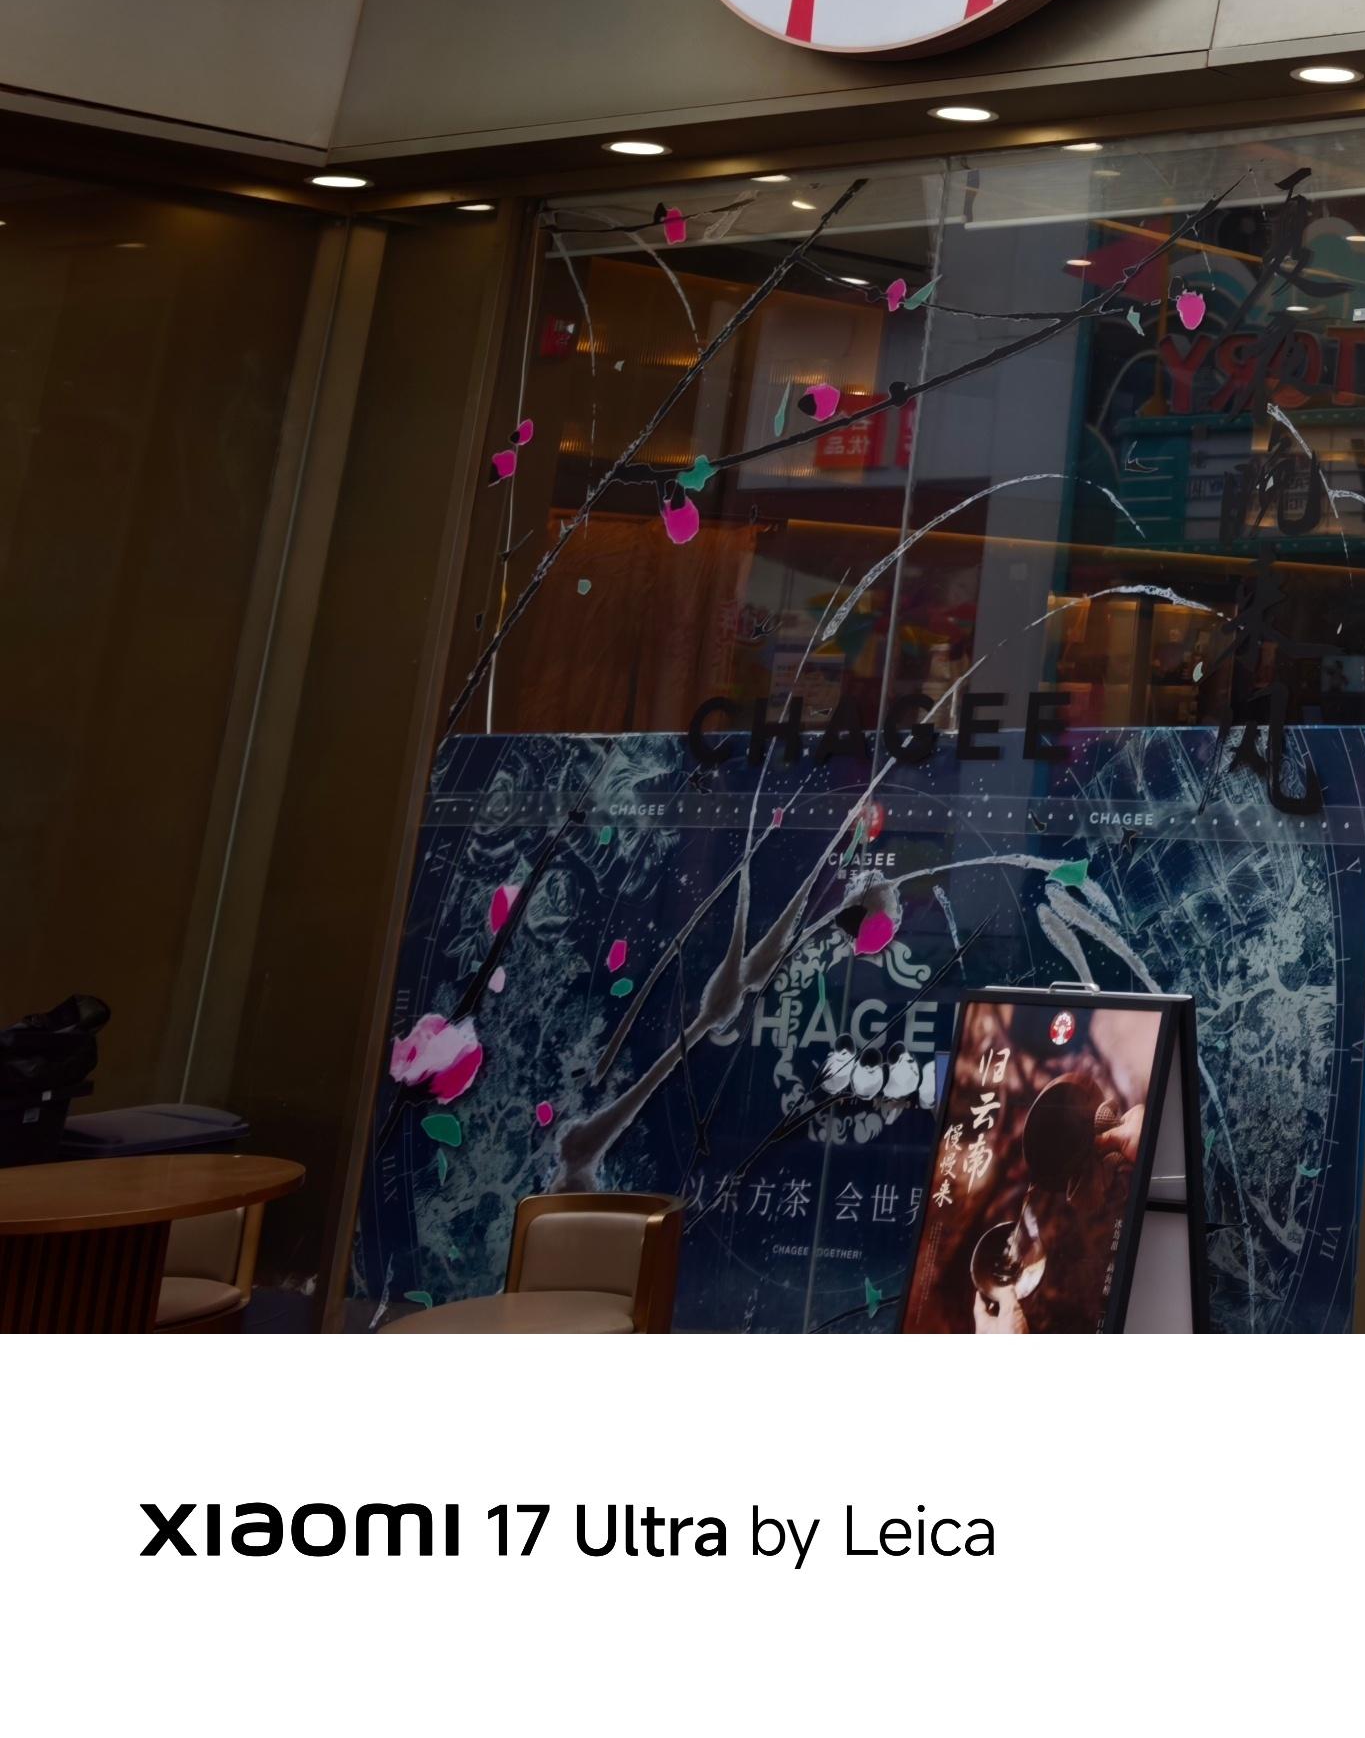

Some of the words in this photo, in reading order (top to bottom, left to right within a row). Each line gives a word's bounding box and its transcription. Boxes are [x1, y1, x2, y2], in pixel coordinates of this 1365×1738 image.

[689, 692, 1072, 766] CHAGEE
[608, 803, 665, 817] CHAGEE
[1089, 811, 1154, 826] CHAGEE
[963, 1047, 1011, 1196] 归云南
[683, 1175, 812, 1219] 以东方茶
[771, 1244, 809, 1257] CHAGEE
